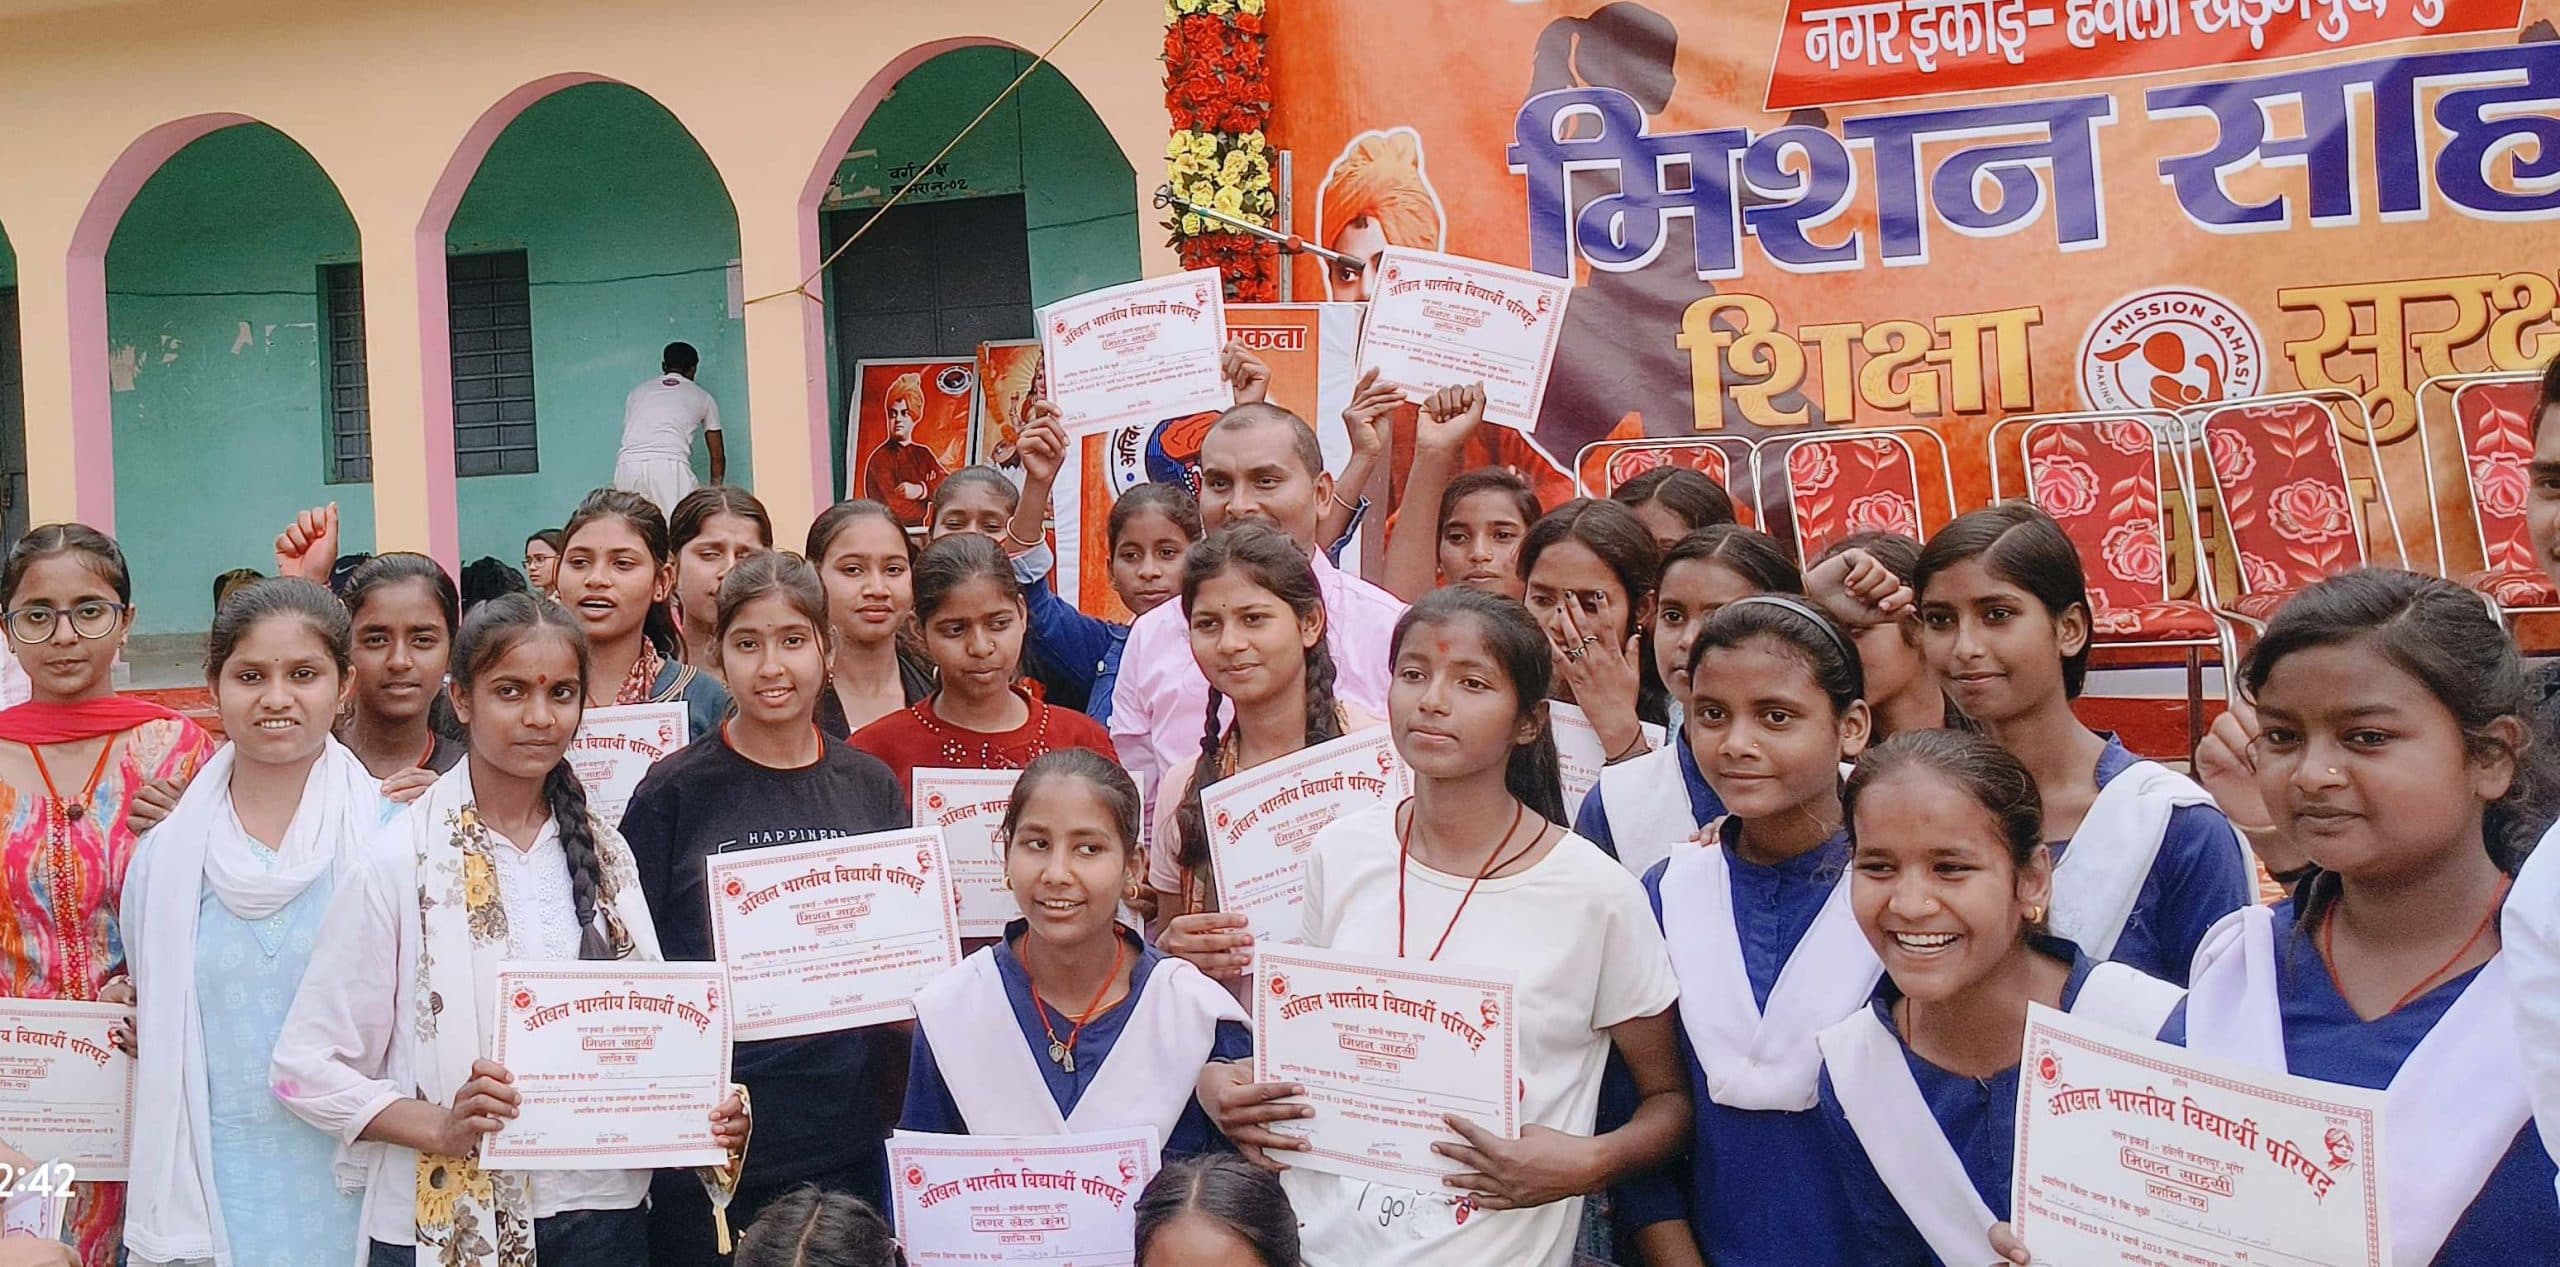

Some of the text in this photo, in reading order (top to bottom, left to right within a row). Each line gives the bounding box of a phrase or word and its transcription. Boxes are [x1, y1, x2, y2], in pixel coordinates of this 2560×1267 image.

[1802, 2, 1903, 70] नगर
[888, 162, 915, 178] वर्ग
[1506, 87, 2117, 284] मिशन
[1676, 293, 2043, 430] शिक्षा
[2110, 301, 2250, 386] MISSION SAHASI
[2095, 365, 2115, 405] MAKING
[1117, 424, 1145, 468] अखि
[937, 804, 977, 827] अखिल
[1227, 808, 1259, 845] अखिल
[1258, 787, 1299, 815] भारतीय
[1301, 771, 1344, 798] विद्यार्थी
[737, 886, 780, 916] अखिल
[783, 868, 830, 893] भारतीय
[835, 863, 883, 883] विद्यार्थी
[886, 867, 926, 897] परिषद्
[523, 990, 711, 1037] अखिल भारतीय विद्यार्थी परिषद्
[1280, 986, 1487, 1055] अखिल भारतीय विद्यार्थी परिषद्
[16, 1026, 68, 1048] विद्यार्थी
[1341, 1035, 1374, 1051] मिशन
[2048, 1083, 2336, 1207] अखिल भारतीय विद्यार्थी परिषद्
[918, 1168, 1127, 1214] अखिल भारतीय विद्यार्थी परिषद्
[2124, 1148, 2231, 1193] मिशन साहसी
[2111, 1231, 2120, 1241] 12
[2141, 1241, 2162, 1254] 2025
